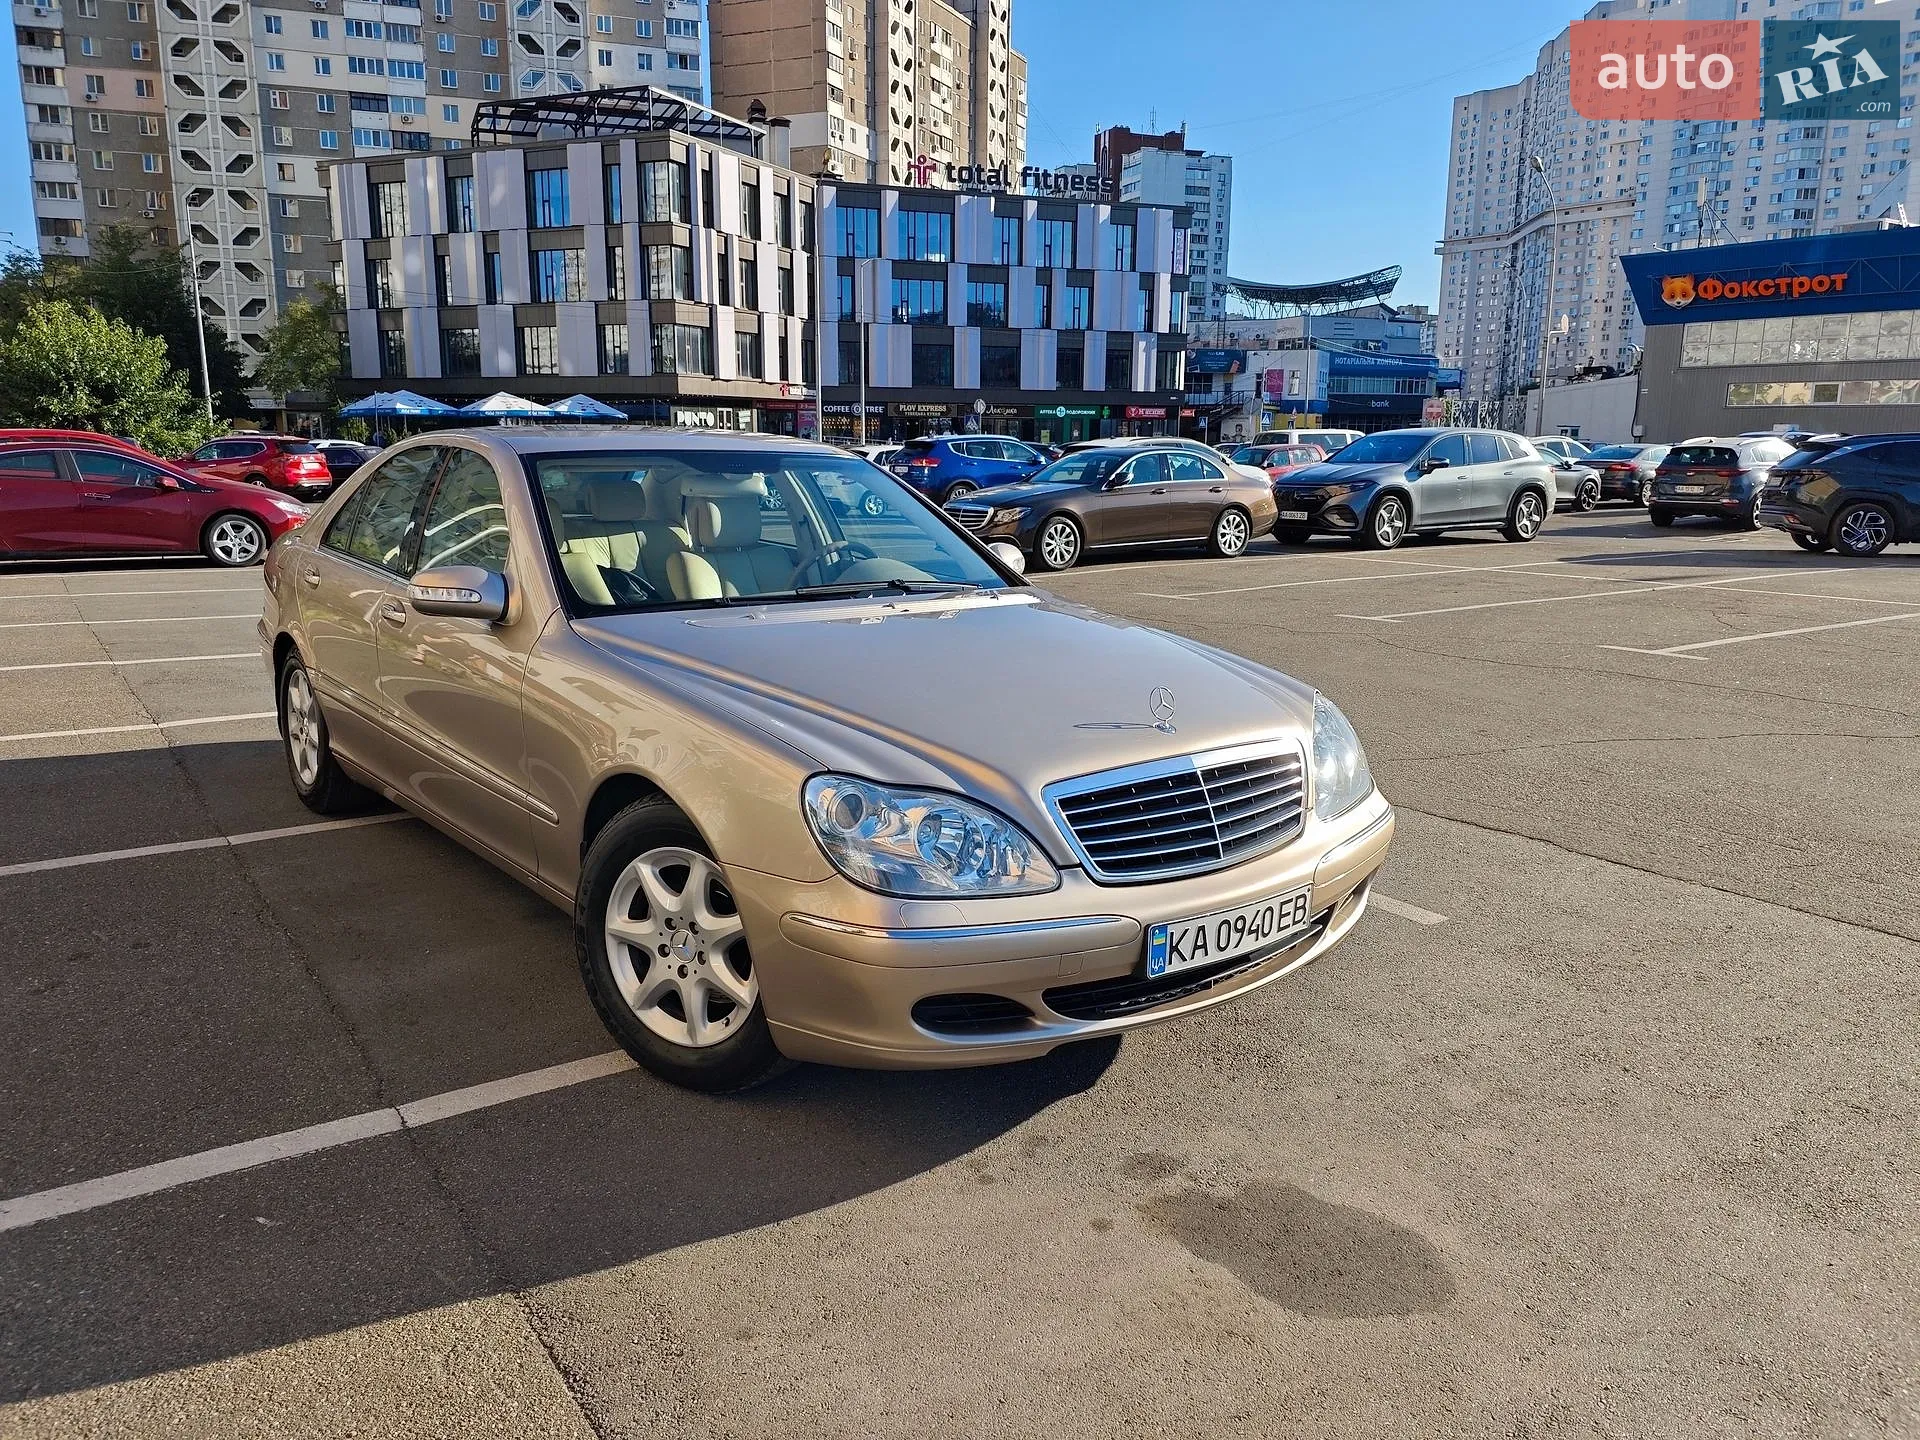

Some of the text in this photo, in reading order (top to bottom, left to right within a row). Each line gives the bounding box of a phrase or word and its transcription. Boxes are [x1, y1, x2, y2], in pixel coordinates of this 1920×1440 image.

[946, 161, 1115, 194] total fitness
[823, 405, 850, 413] COFFEE
[865, 405, 885, 413] TREE
[900, 404, 947, 412] PLOV EXPRESS
[676, 410, 715, 427] PUNTO
[1167, 892, 1308, 966] KA 0940 EB
[1151, 956, 1164, 972] UA
